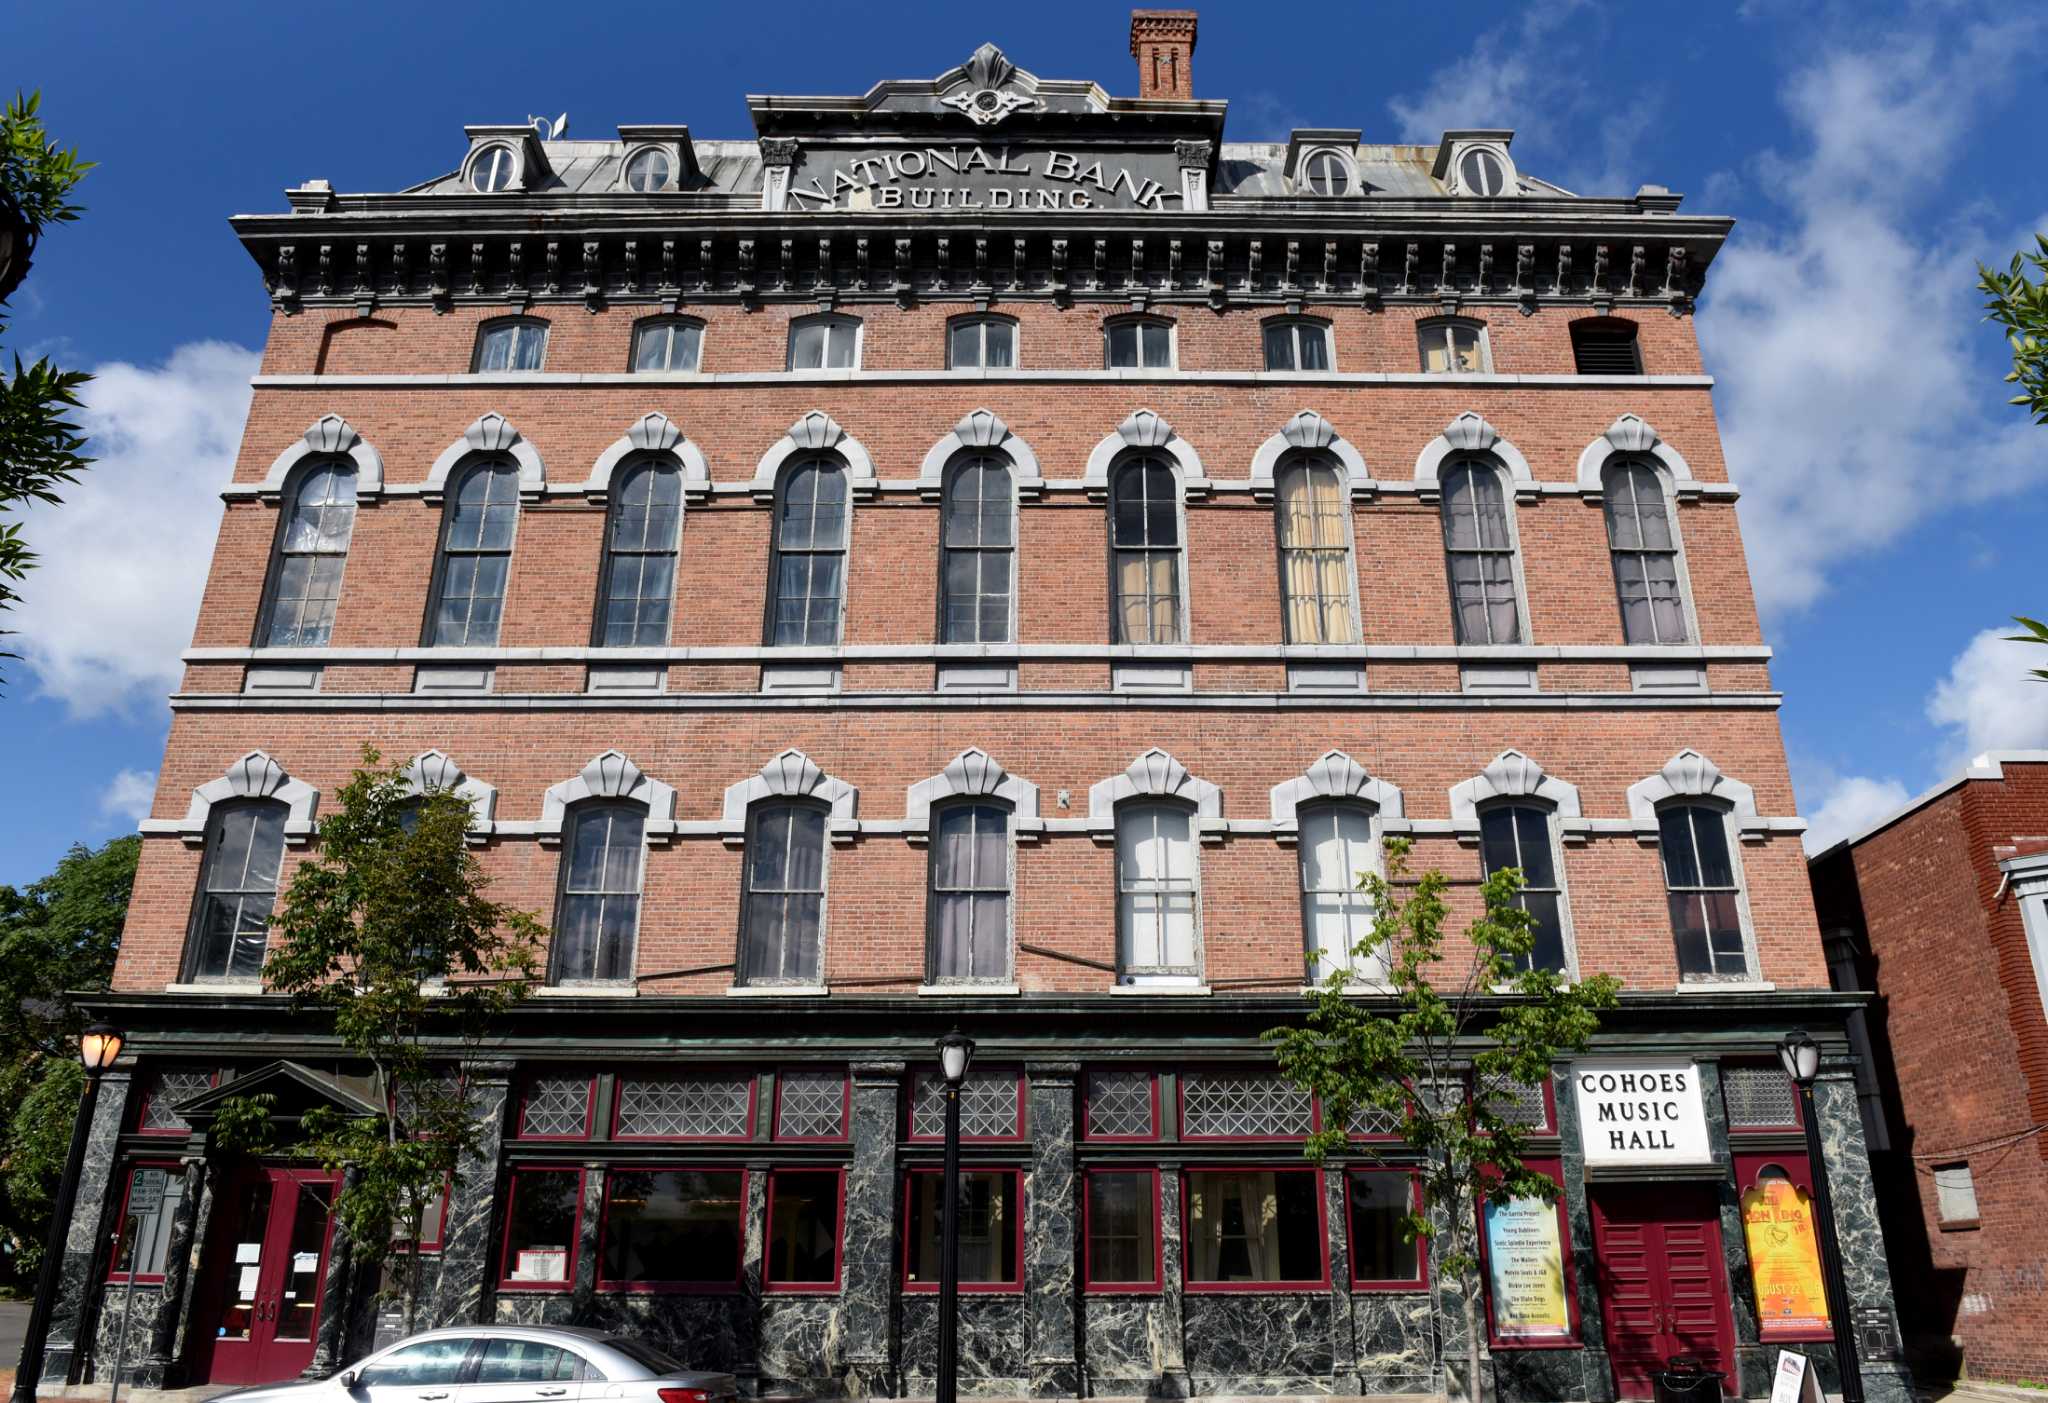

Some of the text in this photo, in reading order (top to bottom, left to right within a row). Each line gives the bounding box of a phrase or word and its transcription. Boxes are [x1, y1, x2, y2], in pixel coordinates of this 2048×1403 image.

[788, 146, 1183, 211] NATIONAL BANK
[1581, 1074, 1687, 1093] COHOES
[1598, 1102, 1679, 1121] MUSIC
[1608, 1130, 1675, 1149] HALL
[134, 1172, 144, 1185] 2
